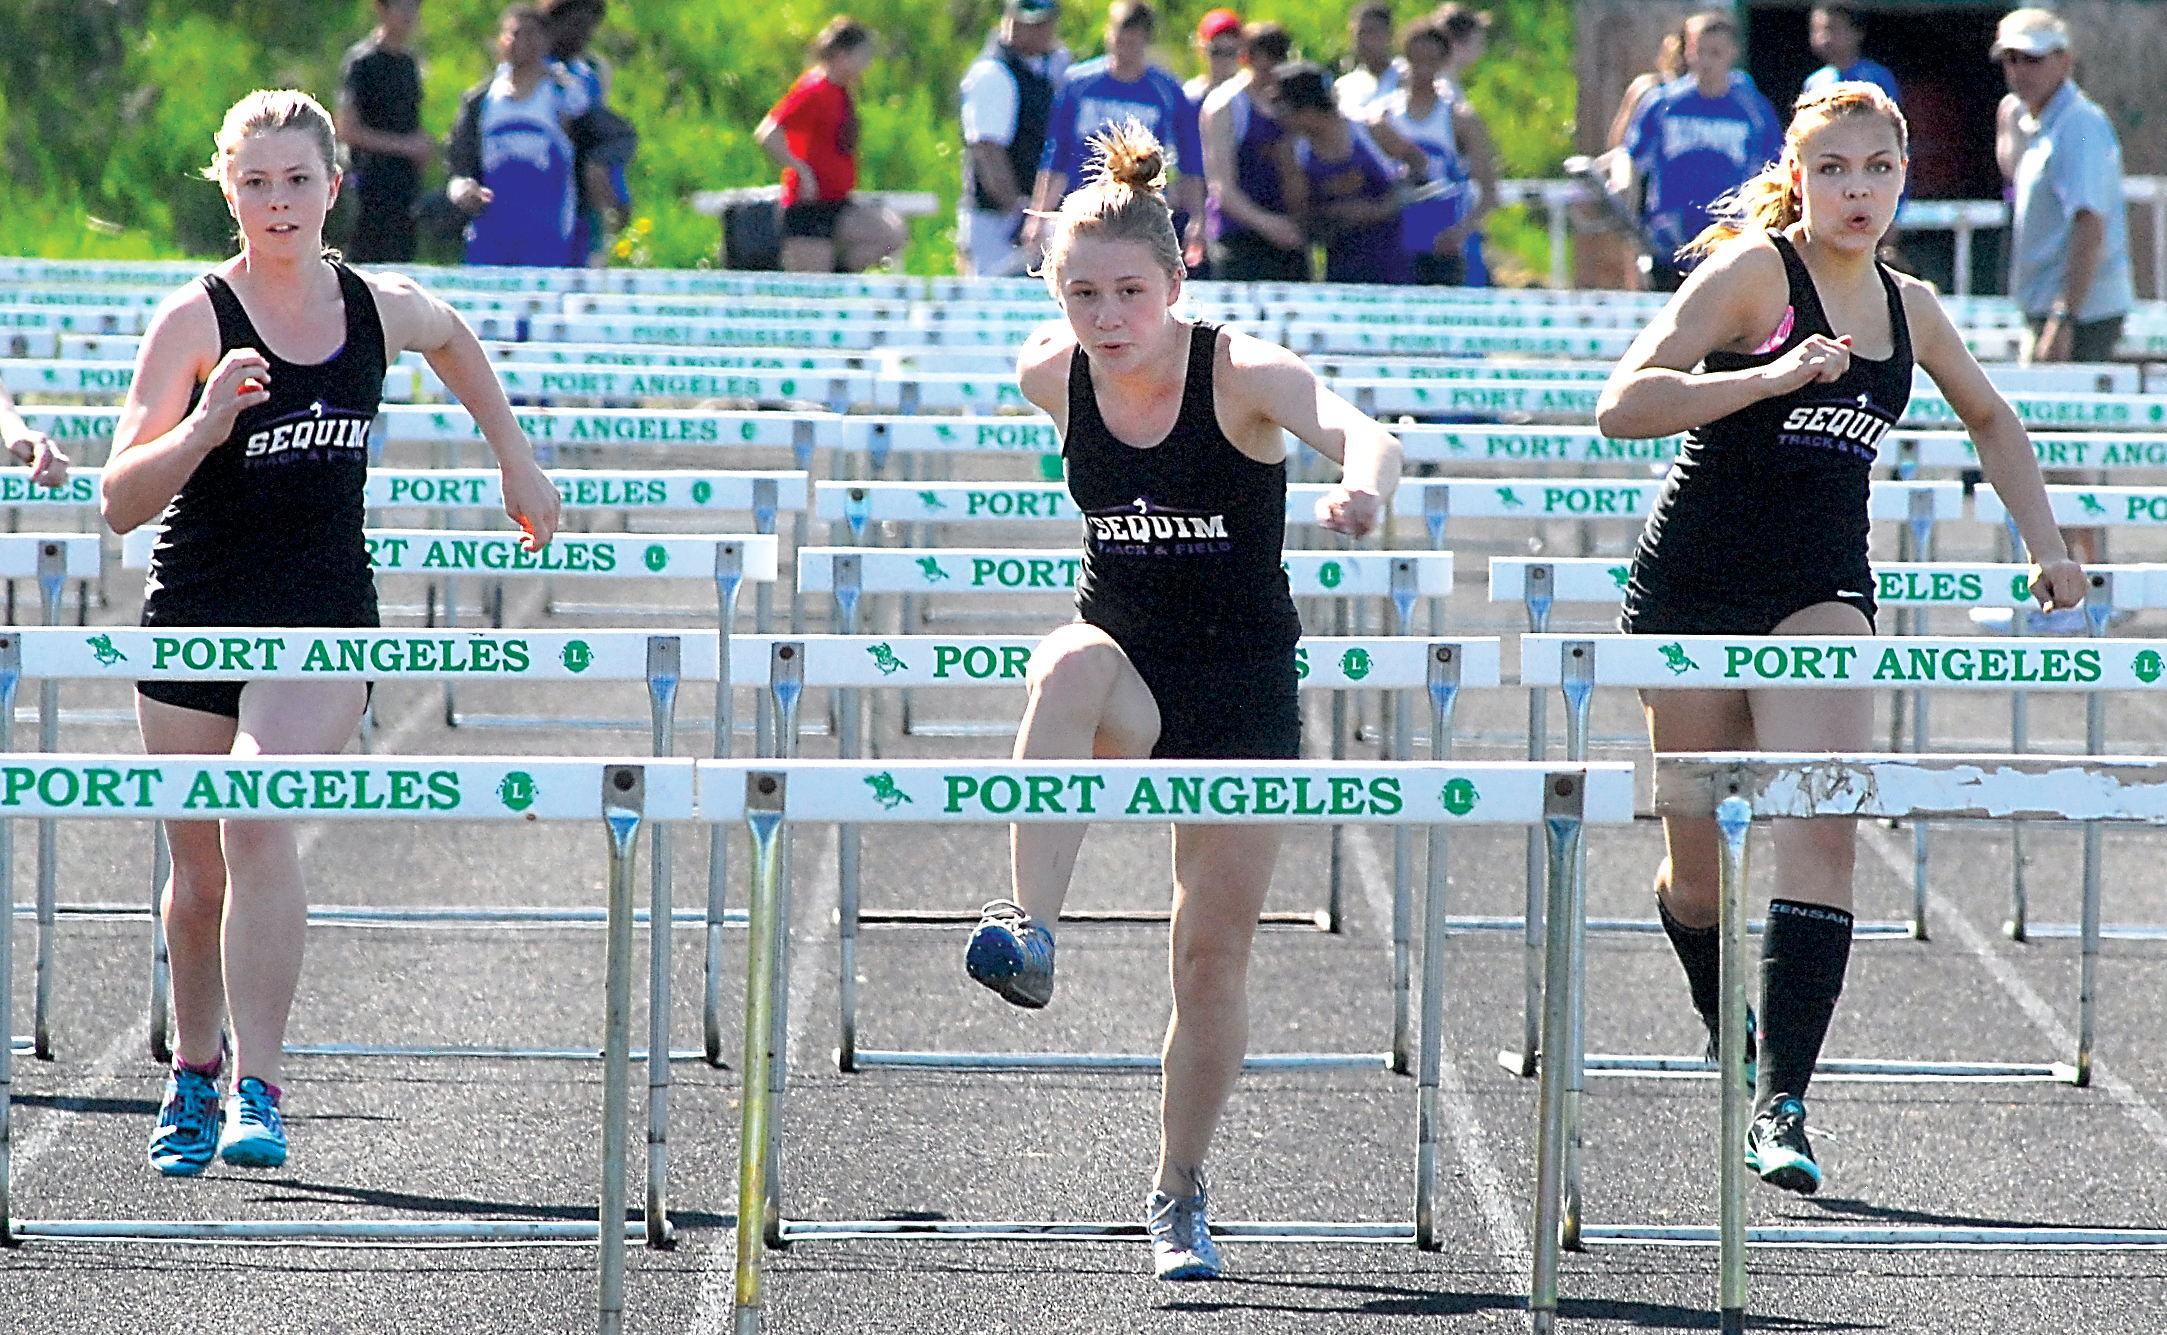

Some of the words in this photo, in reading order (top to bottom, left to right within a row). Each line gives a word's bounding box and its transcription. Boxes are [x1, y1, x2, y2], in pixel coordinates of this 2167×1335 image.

[2016, 401, 2129, 421] NGELES
[245, 418, 370, 458] SEQUIM
[570, 418, 718, 440] ANGELES
[1487, 436, 1571, 456] PORT
[391, 478, 487, 504] PORT
[968, 492, 1065, 516] PORT
[1544, 488, 1641, 513] PORT
[1088, 514, 1229, 543] SEQUIM
[364, 538, 409, 568] RT
[423, 540, 617, 571] ANGELES
[1175, 541, 1232, 555] FIELD
[972, 558, 1081, 587] PORT
[1877, 572, 1983, 601] ELES
[155, 637, 286, 671] PORT
[303, 639, 530, 672] ANGELES
[934, 645, 1030, 679] POR
[1725, 646, 1855, 679] PORT
[1873, 648, 2102, 682] ANGELES
[3, 767, 164, 807] PORT
[185, 770, 462, 810] ANGELES
[944, 775, 1105, 813] PORT
[1126, 777, 1403, 815] ANGELES
